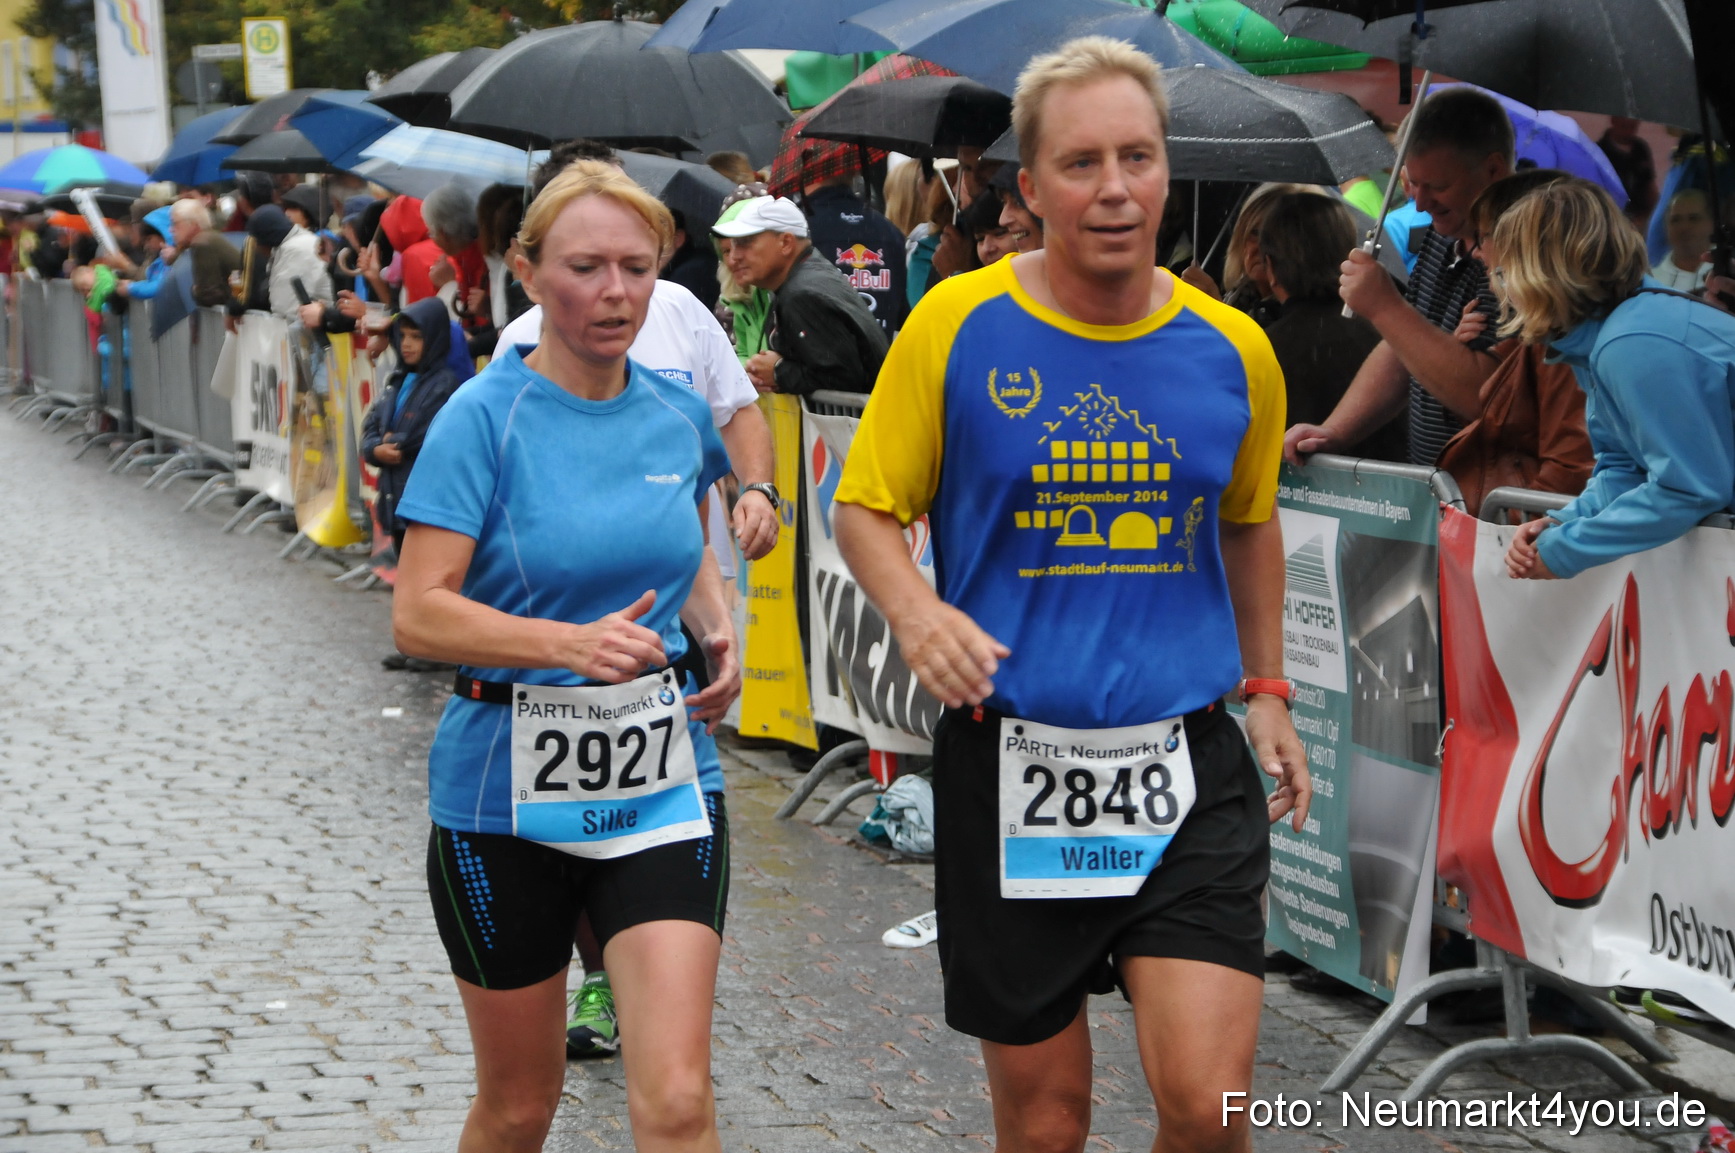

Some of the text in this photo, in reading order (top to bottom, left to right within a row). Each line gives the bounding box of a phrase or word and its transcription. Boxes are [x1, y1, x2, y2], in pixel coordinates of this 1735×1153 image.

[1006, 372, 1022, 383] 15
[1000, 387, 1031, 398] Jahre
[1036, 490, 1168, 505] 21.September 2014
[1292, 486, 1304, 502] und
[1385, 500, 1411, 524] Bayern
[1018, 561, 1184, 578] www.stadtlauf-neumarkt.de
[1294, 600, 1337, 631] HOFFER
[517, 695, 655, 720] PARTL Neumarkt
[1291, 709, 1323, 736] Neumarkt
[534, 715, 673, 792] 2927
[1006, 736, 1160, 759] PARTL Neumarkt
[1311, 742, 1337, 770] 460170
[520, 790, 528, 801] D
[1023, 763, 1178, 828] 2848
[582, 809, 638, 835] Silke
[1009, 824, 1017, 835] D
[1061, 846, 1143, 871] Walter
[1300, 892, 1350, 930] Sanierungen
